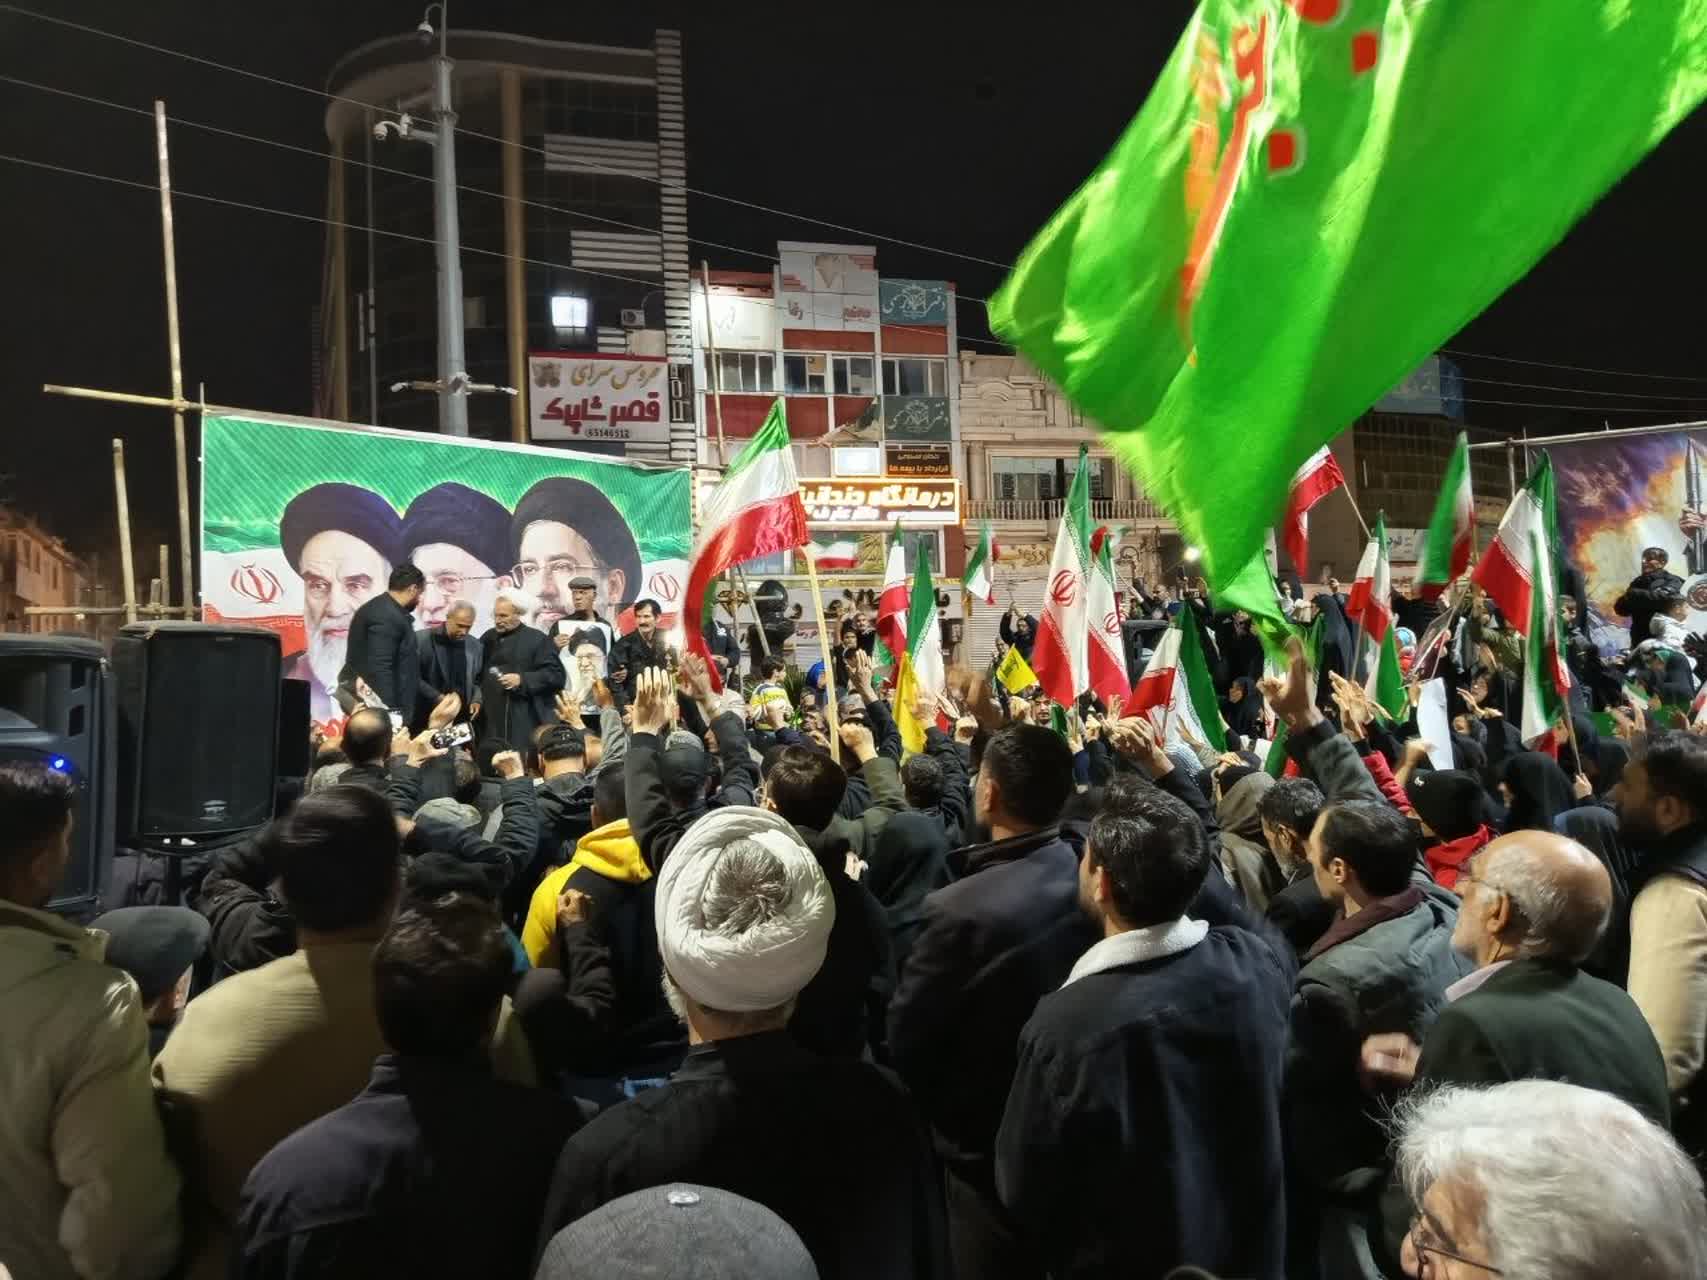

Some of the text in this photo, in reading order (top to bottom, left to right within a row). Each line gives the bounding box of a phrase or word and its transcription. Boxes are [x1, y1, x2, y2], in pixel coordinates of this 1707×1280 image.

[540, 391, 660, 435] قصر شاپرک
[868, 485, 955, 509] درمانگاه
